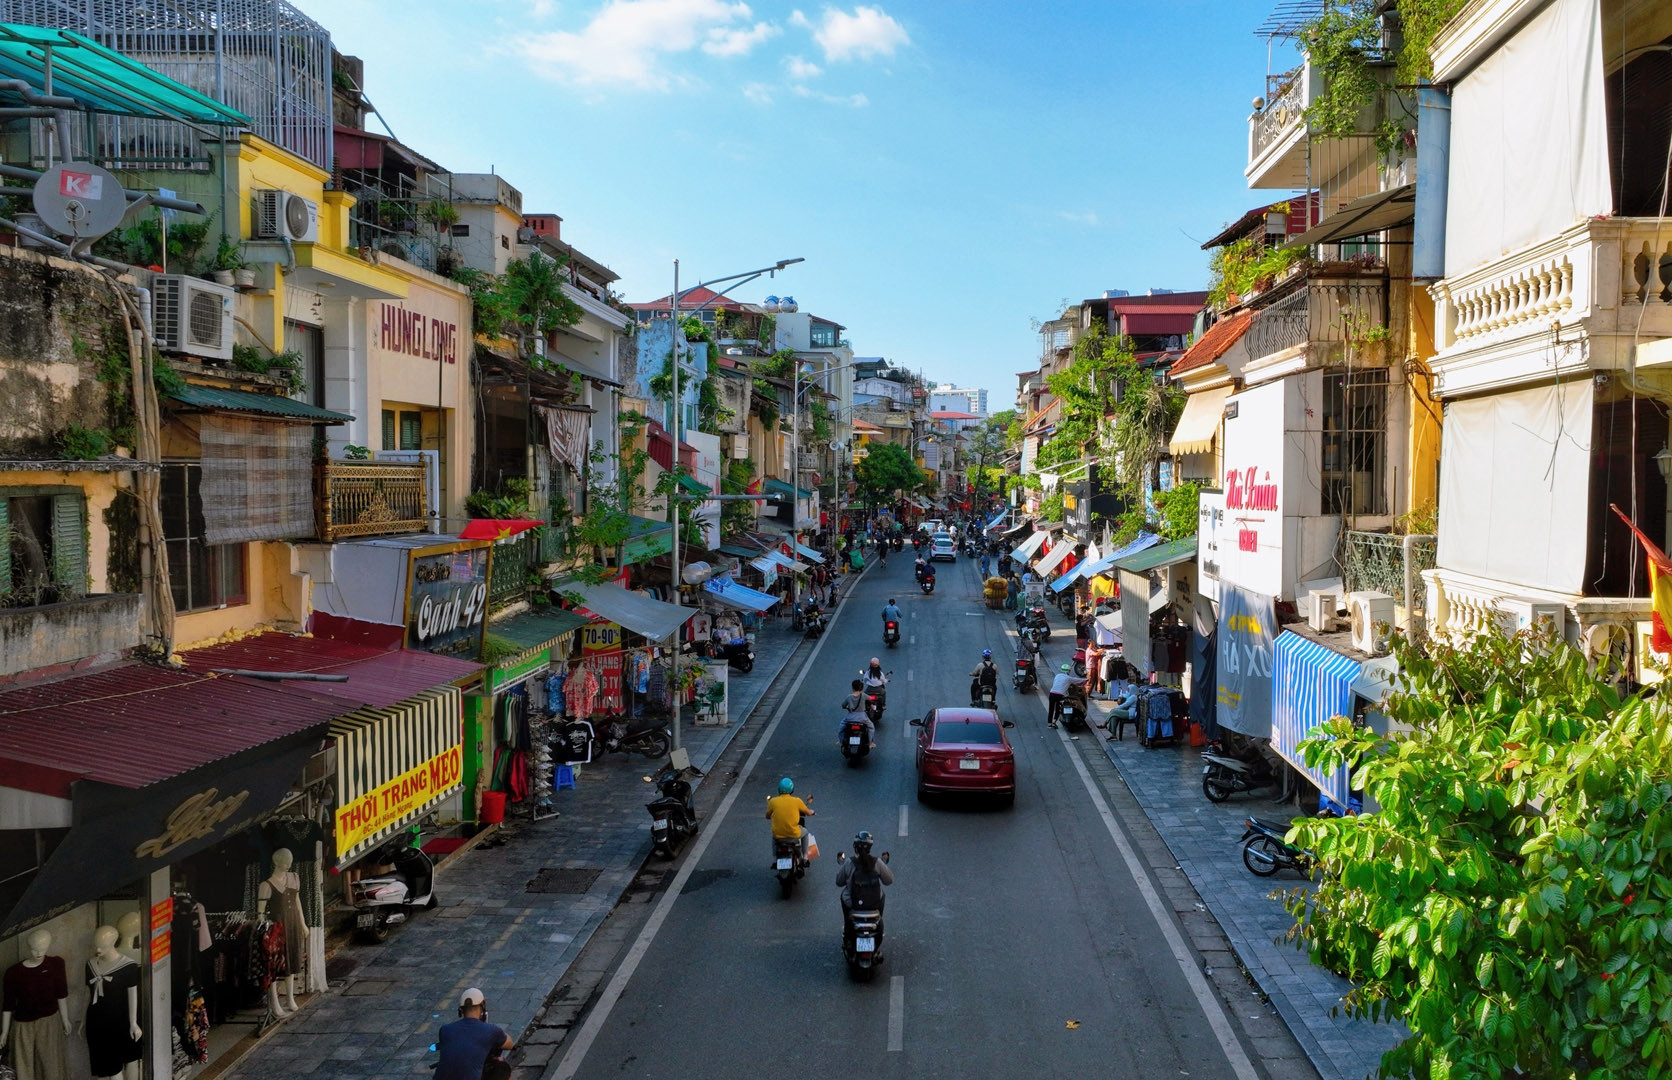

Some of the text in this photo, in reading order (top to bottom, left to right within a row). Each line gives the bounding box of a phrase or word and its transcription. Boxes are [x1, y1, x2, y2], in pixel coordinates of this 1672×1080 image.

[418, 583, 487, 641] Oanh 42
[1223, 634, 1240, 675] HÀ
[340, 795, 377, 836] THỜI
[382, 769, 427, 811] TRANG
